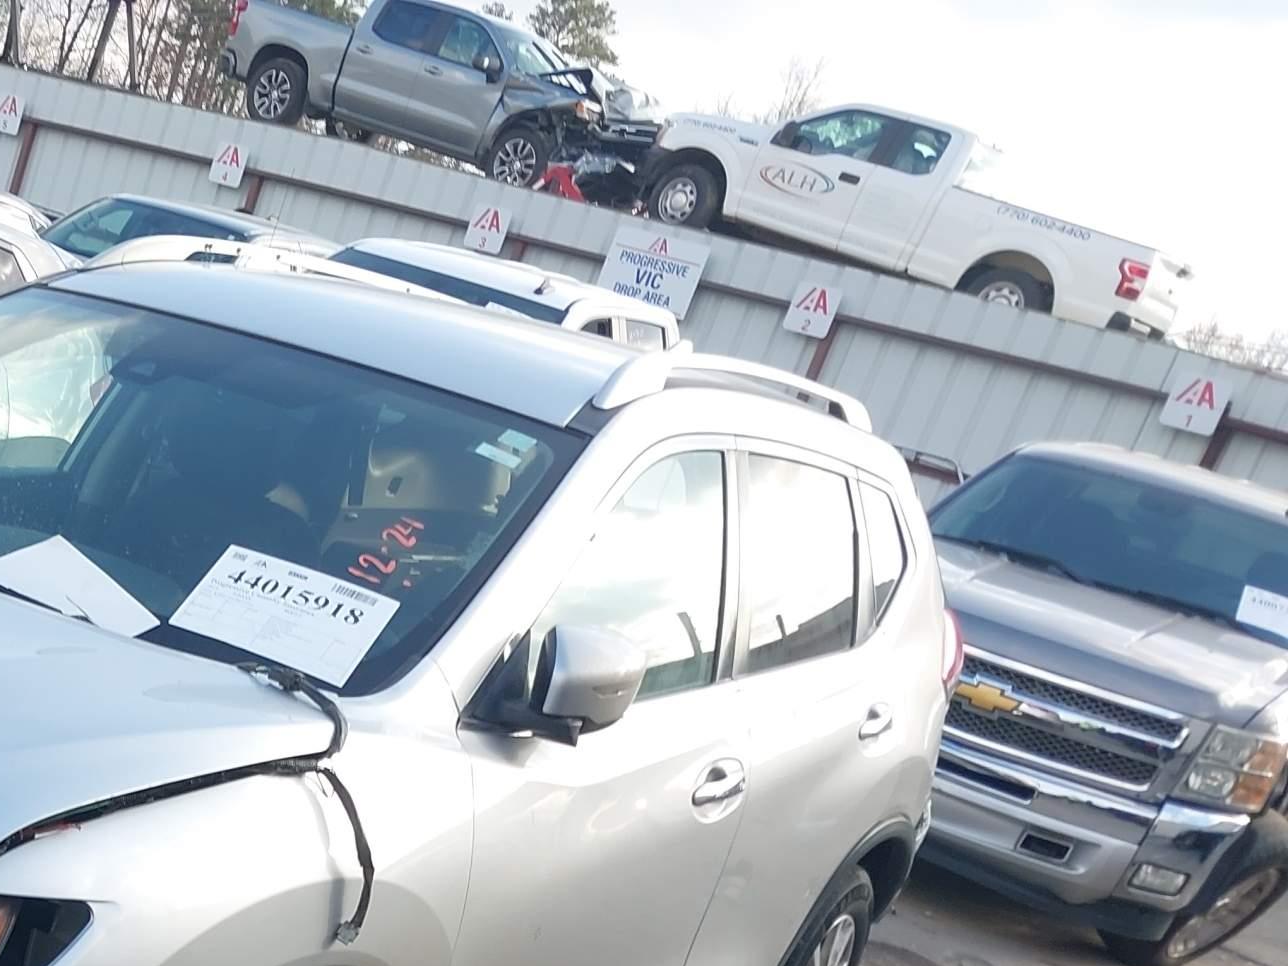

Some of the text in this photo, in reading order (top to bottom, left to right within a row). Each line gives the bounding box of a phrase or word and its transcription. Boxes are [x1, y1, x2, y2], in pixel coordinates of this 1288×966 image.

[772, 168, 817, 192] ALH
[619, 249, 690, 278] PROGRESSIVE
[635, 268, 664, 290] VIC
[613, 281, 670, 308] DROP AREA
[801, 319, 811, 332] 2
[228, 569, 364, 625] 44015918
